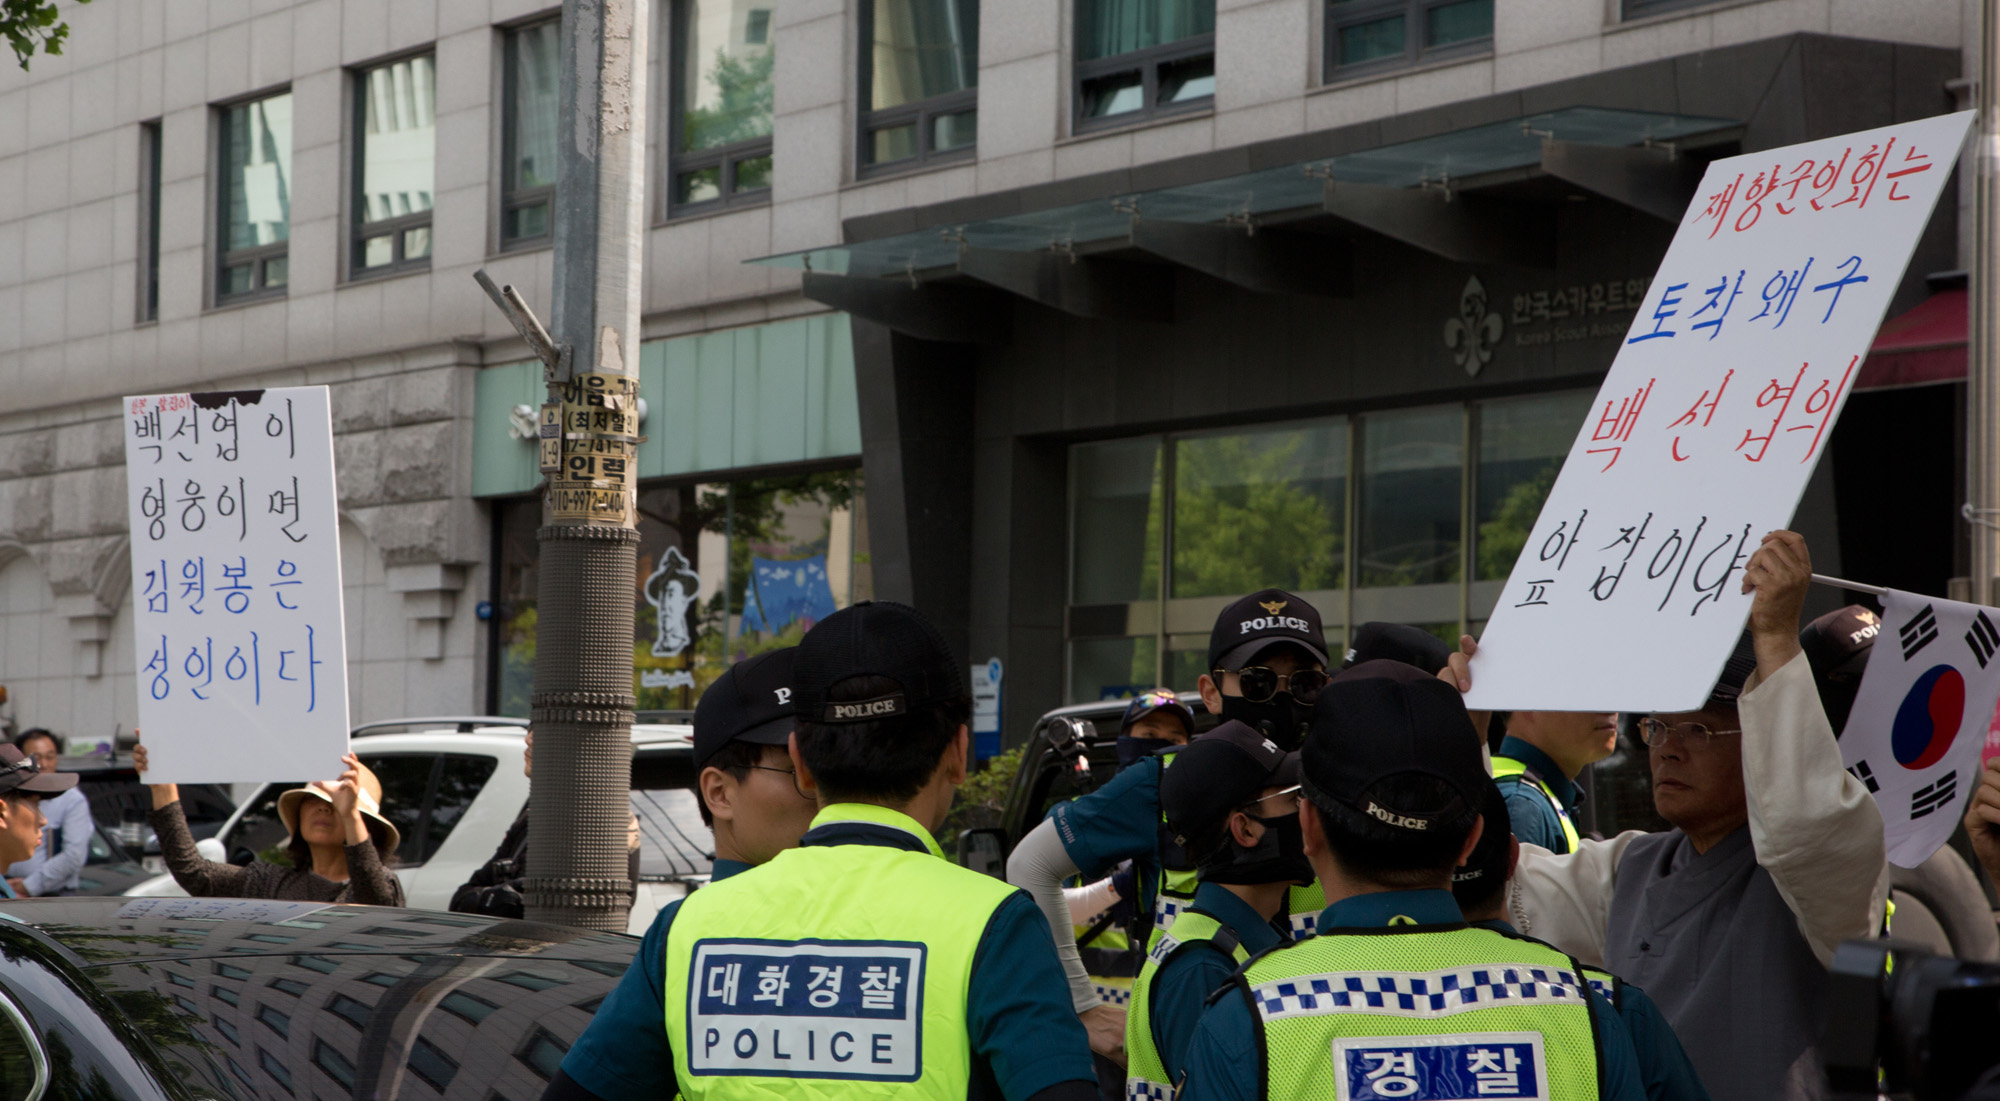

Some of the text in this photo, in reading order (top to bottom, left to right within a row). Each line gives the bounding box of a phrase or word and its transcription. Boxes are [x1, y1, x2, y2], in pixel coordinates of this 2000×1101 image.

[1512, 276, 1653, 324] 한국스카우트연
[1240, 615, 1310, 635] POLICE
[834, 698, 896, 719] POLICE
[1366, 800, 1429, 831] POLICE
[704, 1027, 894, 1065] POLICE
[1363, 1047, 1522, 1098] 경찰
